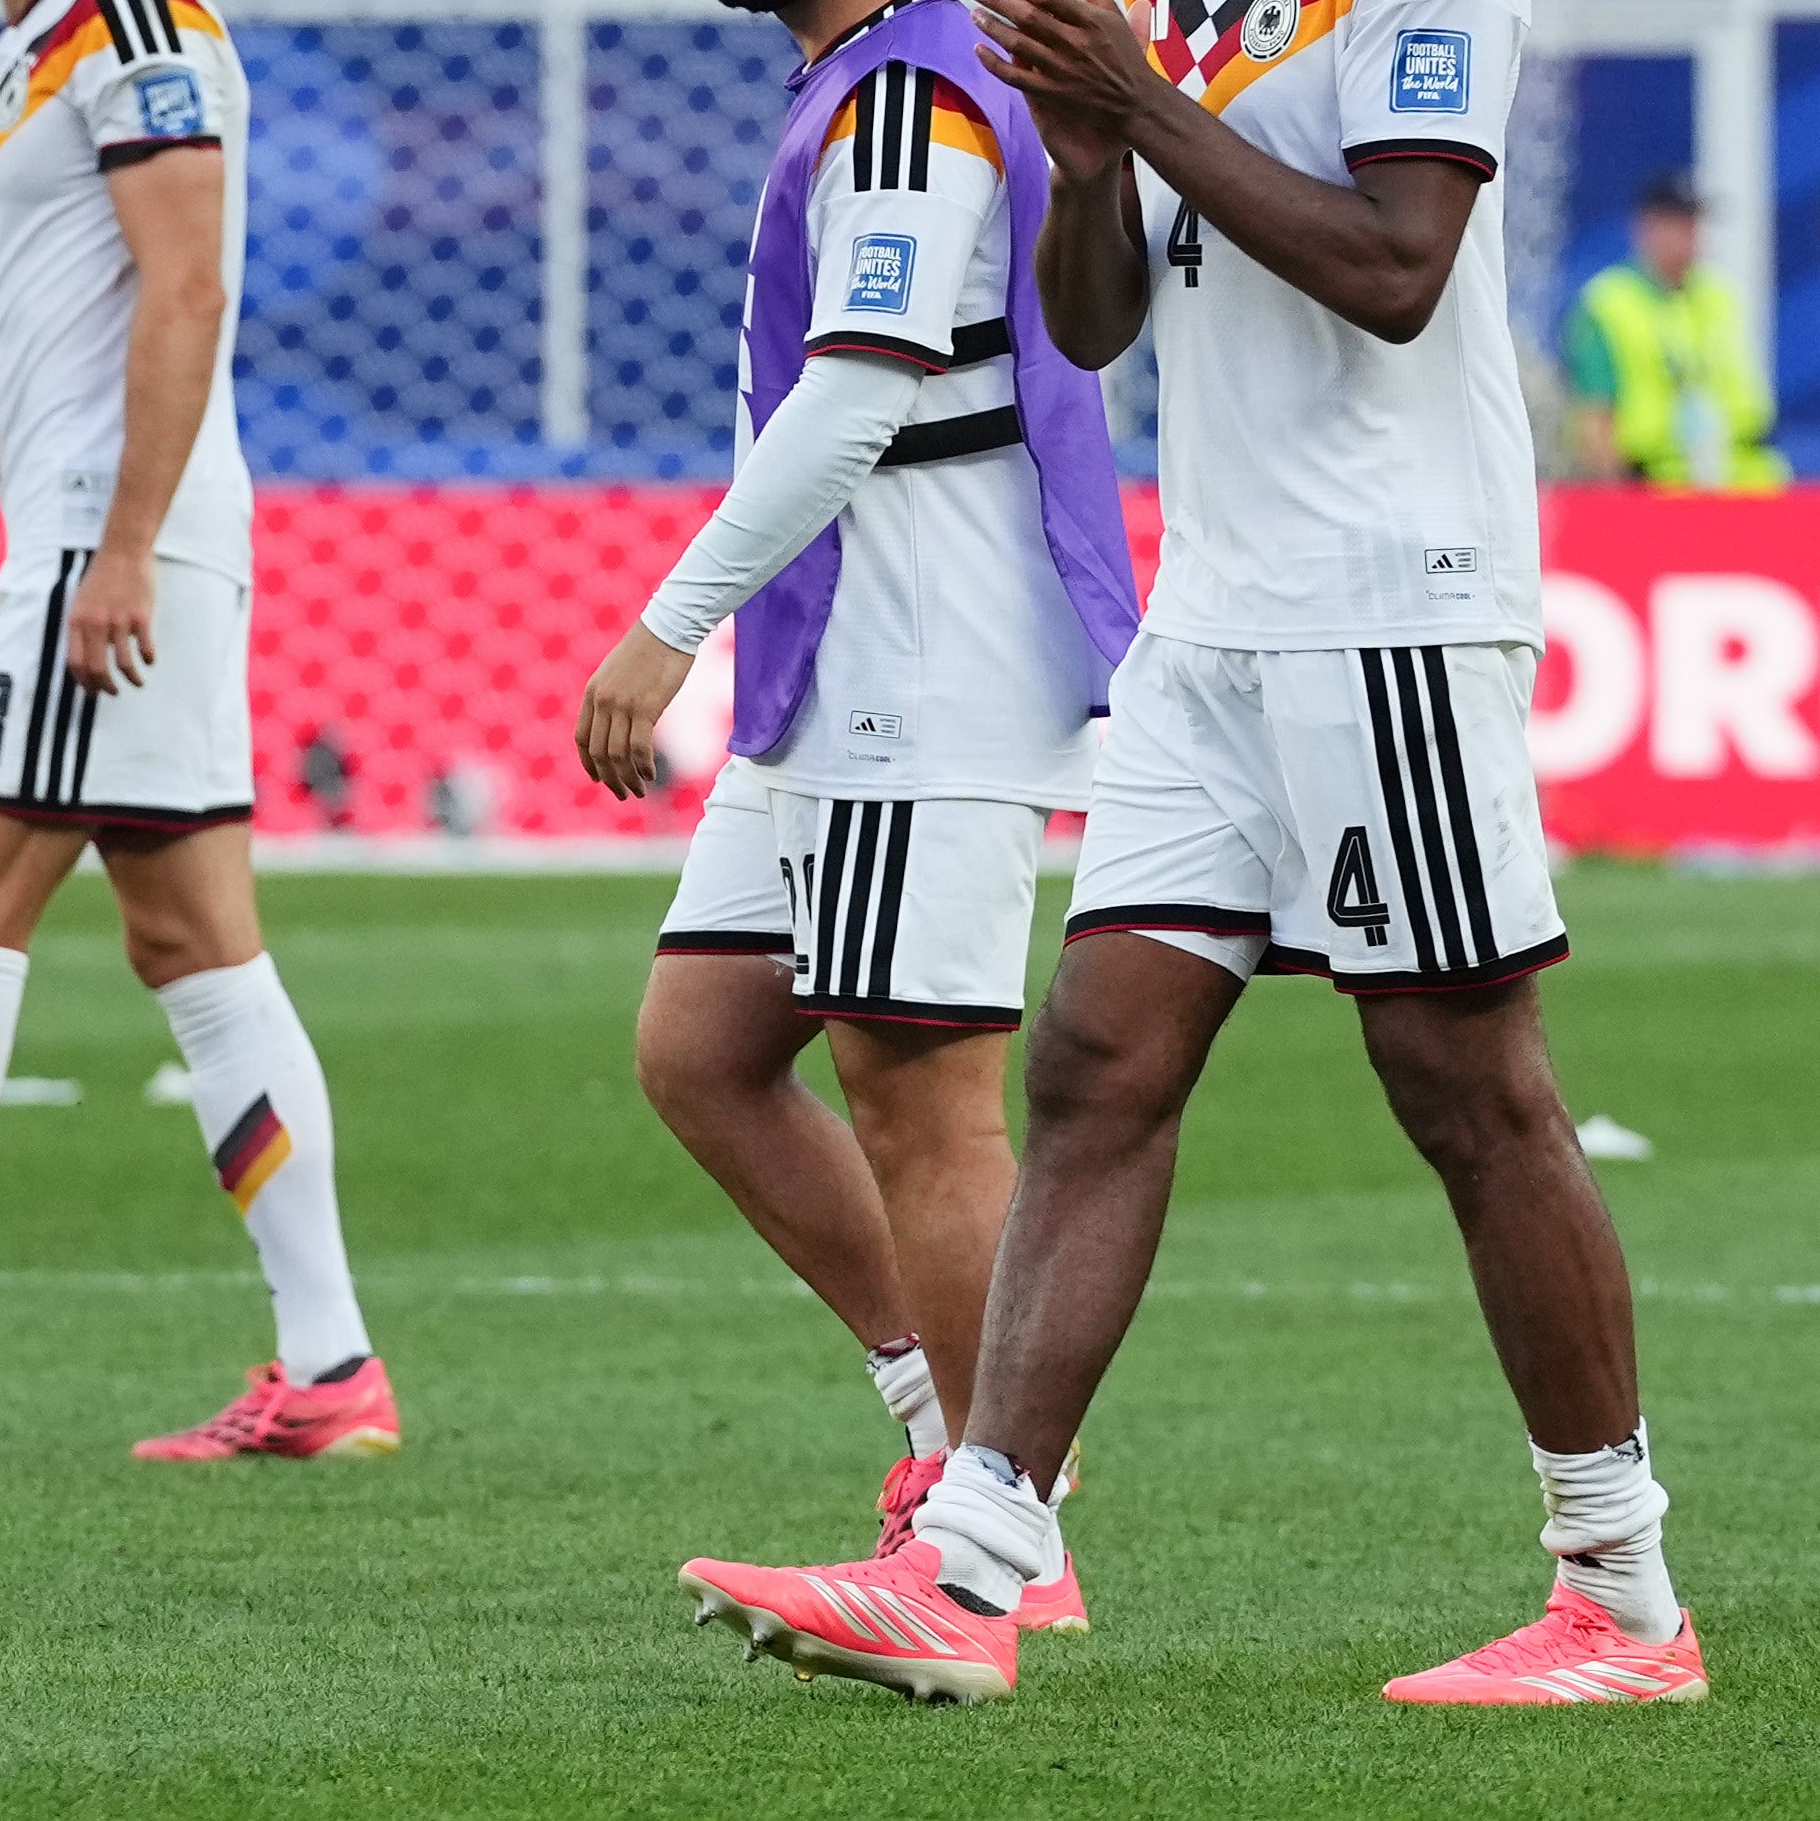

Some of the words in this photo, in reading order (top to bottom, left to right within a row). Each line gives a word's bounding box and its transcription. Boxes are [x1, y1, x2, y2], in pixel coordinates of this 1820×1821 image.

[1406, 43, 1456, 58] FOOTBALL
[1405, 56, 1456, 76] UNITES
[1422, 75, 1459, 92] World
[1417, 91, 1441, 100] FIFA
[1167, 197, 1203, 289] 4
[855, 258, 902, 277] UNITES
[867, 275, 902, 293] World
[1326, 825, 1391, 947] 4
